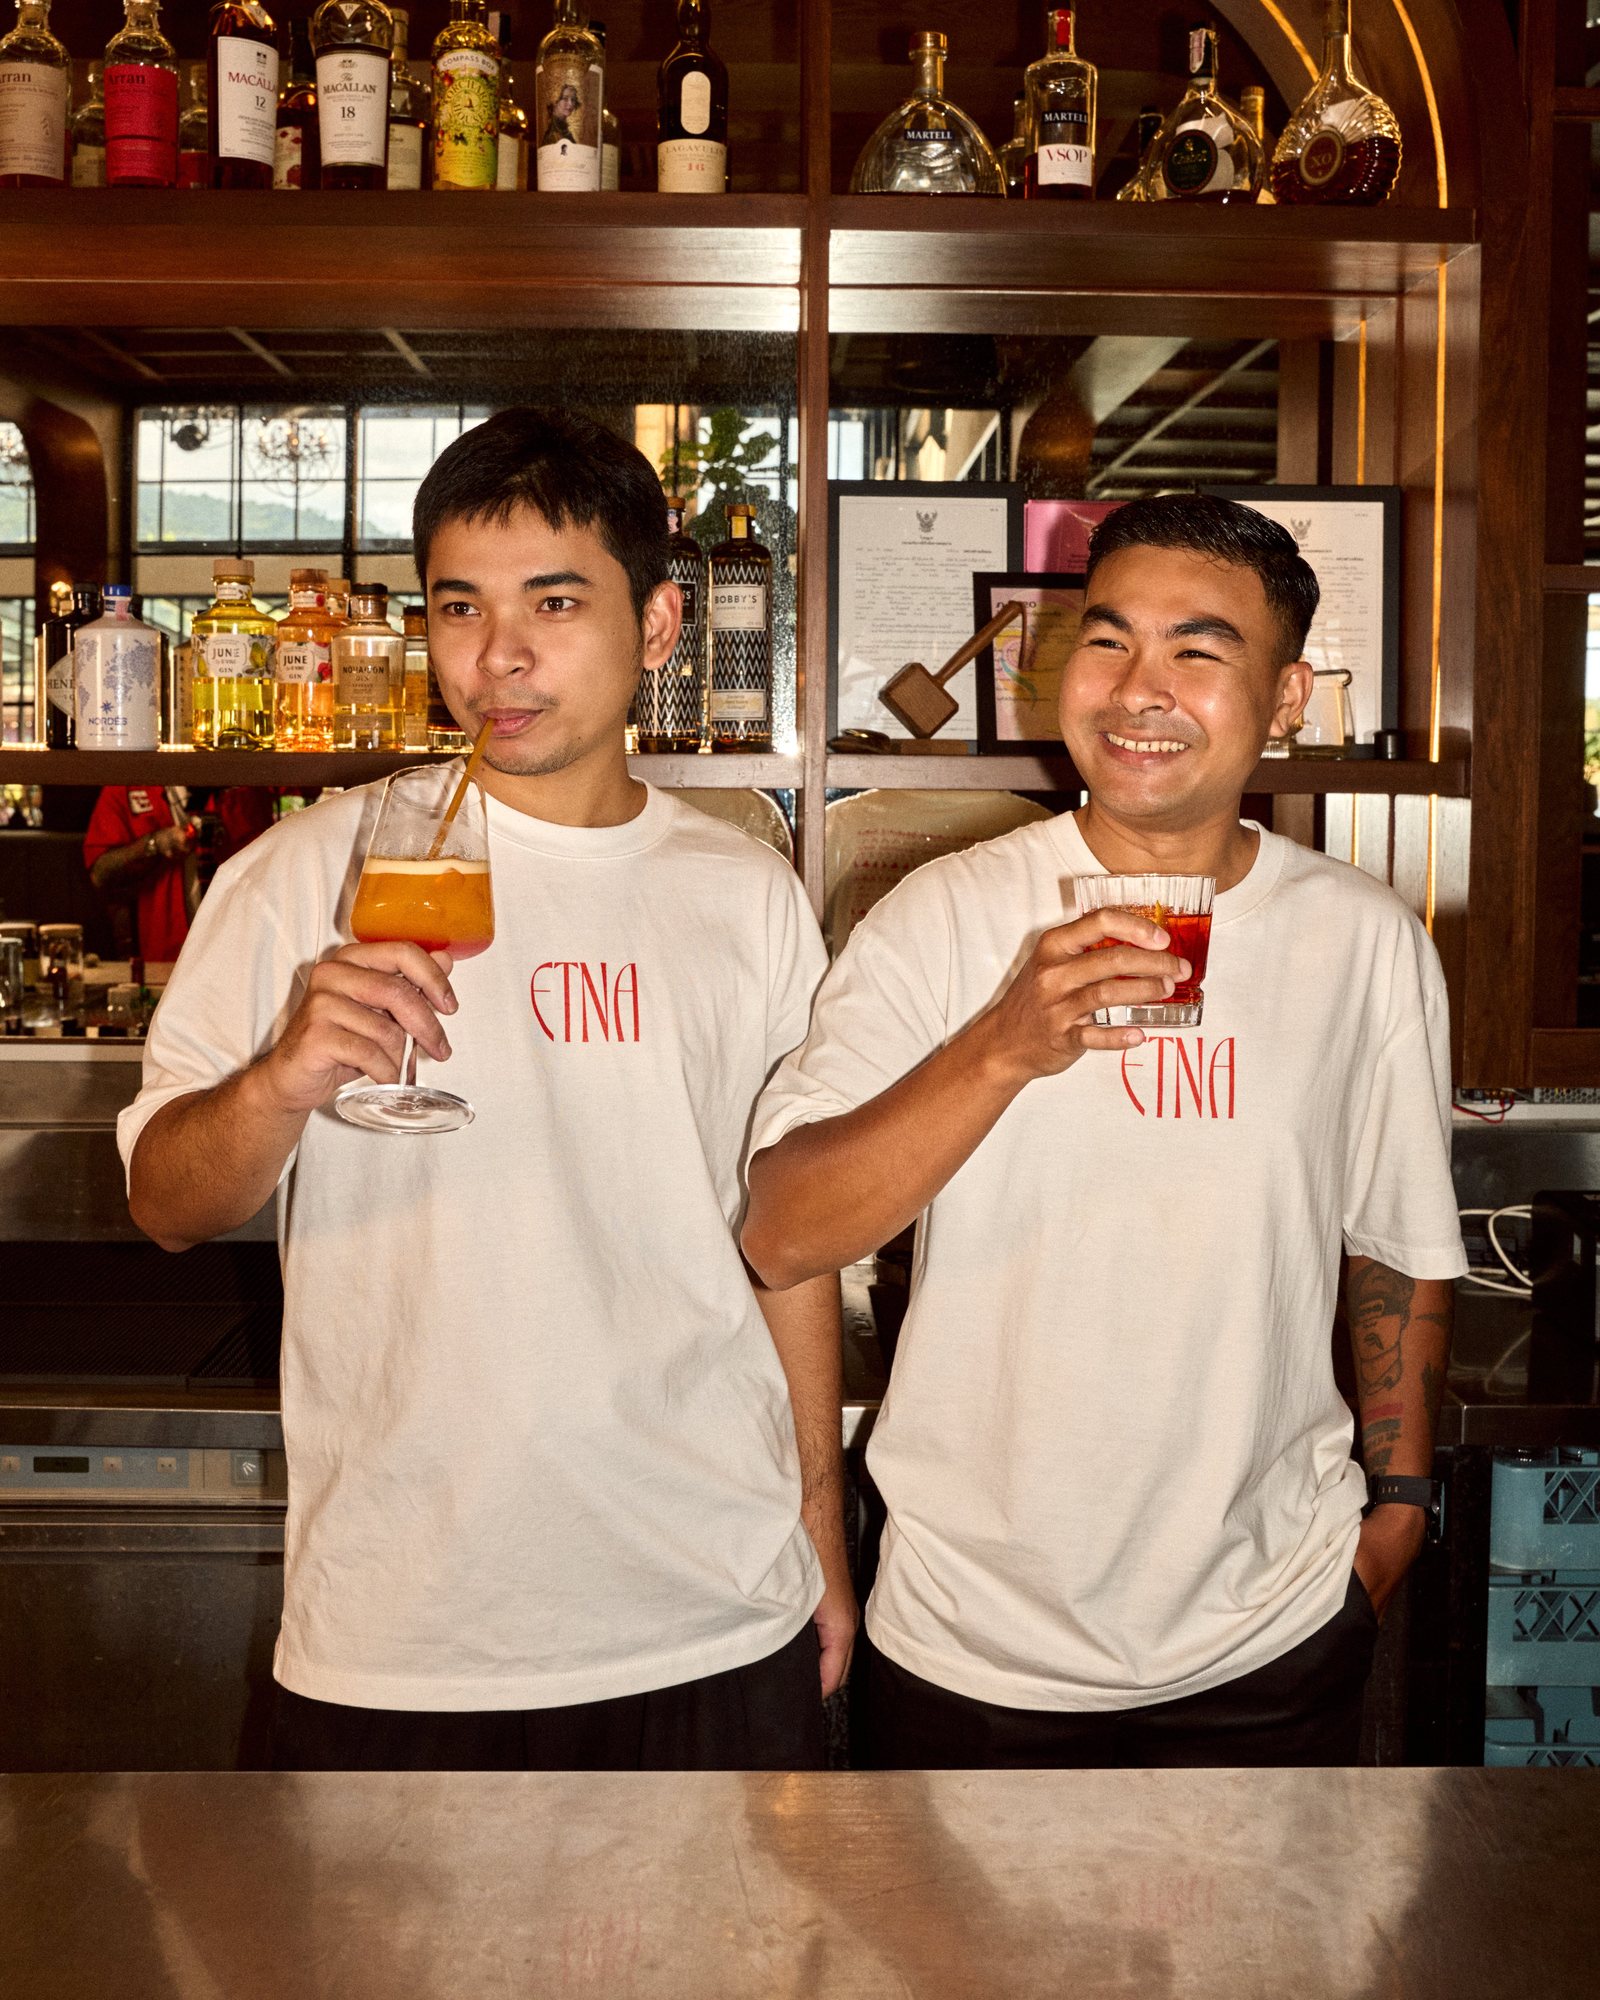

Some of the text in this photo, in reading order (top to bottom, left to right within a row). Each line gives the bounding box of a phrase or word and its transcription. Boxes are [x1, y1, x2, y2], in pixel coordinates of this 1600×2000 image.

[442, 55, 480, 67] COMPASS
[0, 72, 32, 84] rran
[108, 74, 146, 85] Arran
[323, 83, 377, 95] MACALLAN
[255, 95, 266, 109] 12
[340, 106, 356, 119] 18
[1044, 111, 1089, 124] MARTELL
[906, 130, 953, 140] MARTELL
[1045, 149, 1088, 163] VSOP
[714, 594, 758, 605] BOBBY'S
[211, 647, 241, 660] JUNE
[283, 655, 308, 667] JUNE
[530, 961, 640, 1042] ETNA
[1121, 1036, 1235, 1119] ETNA
